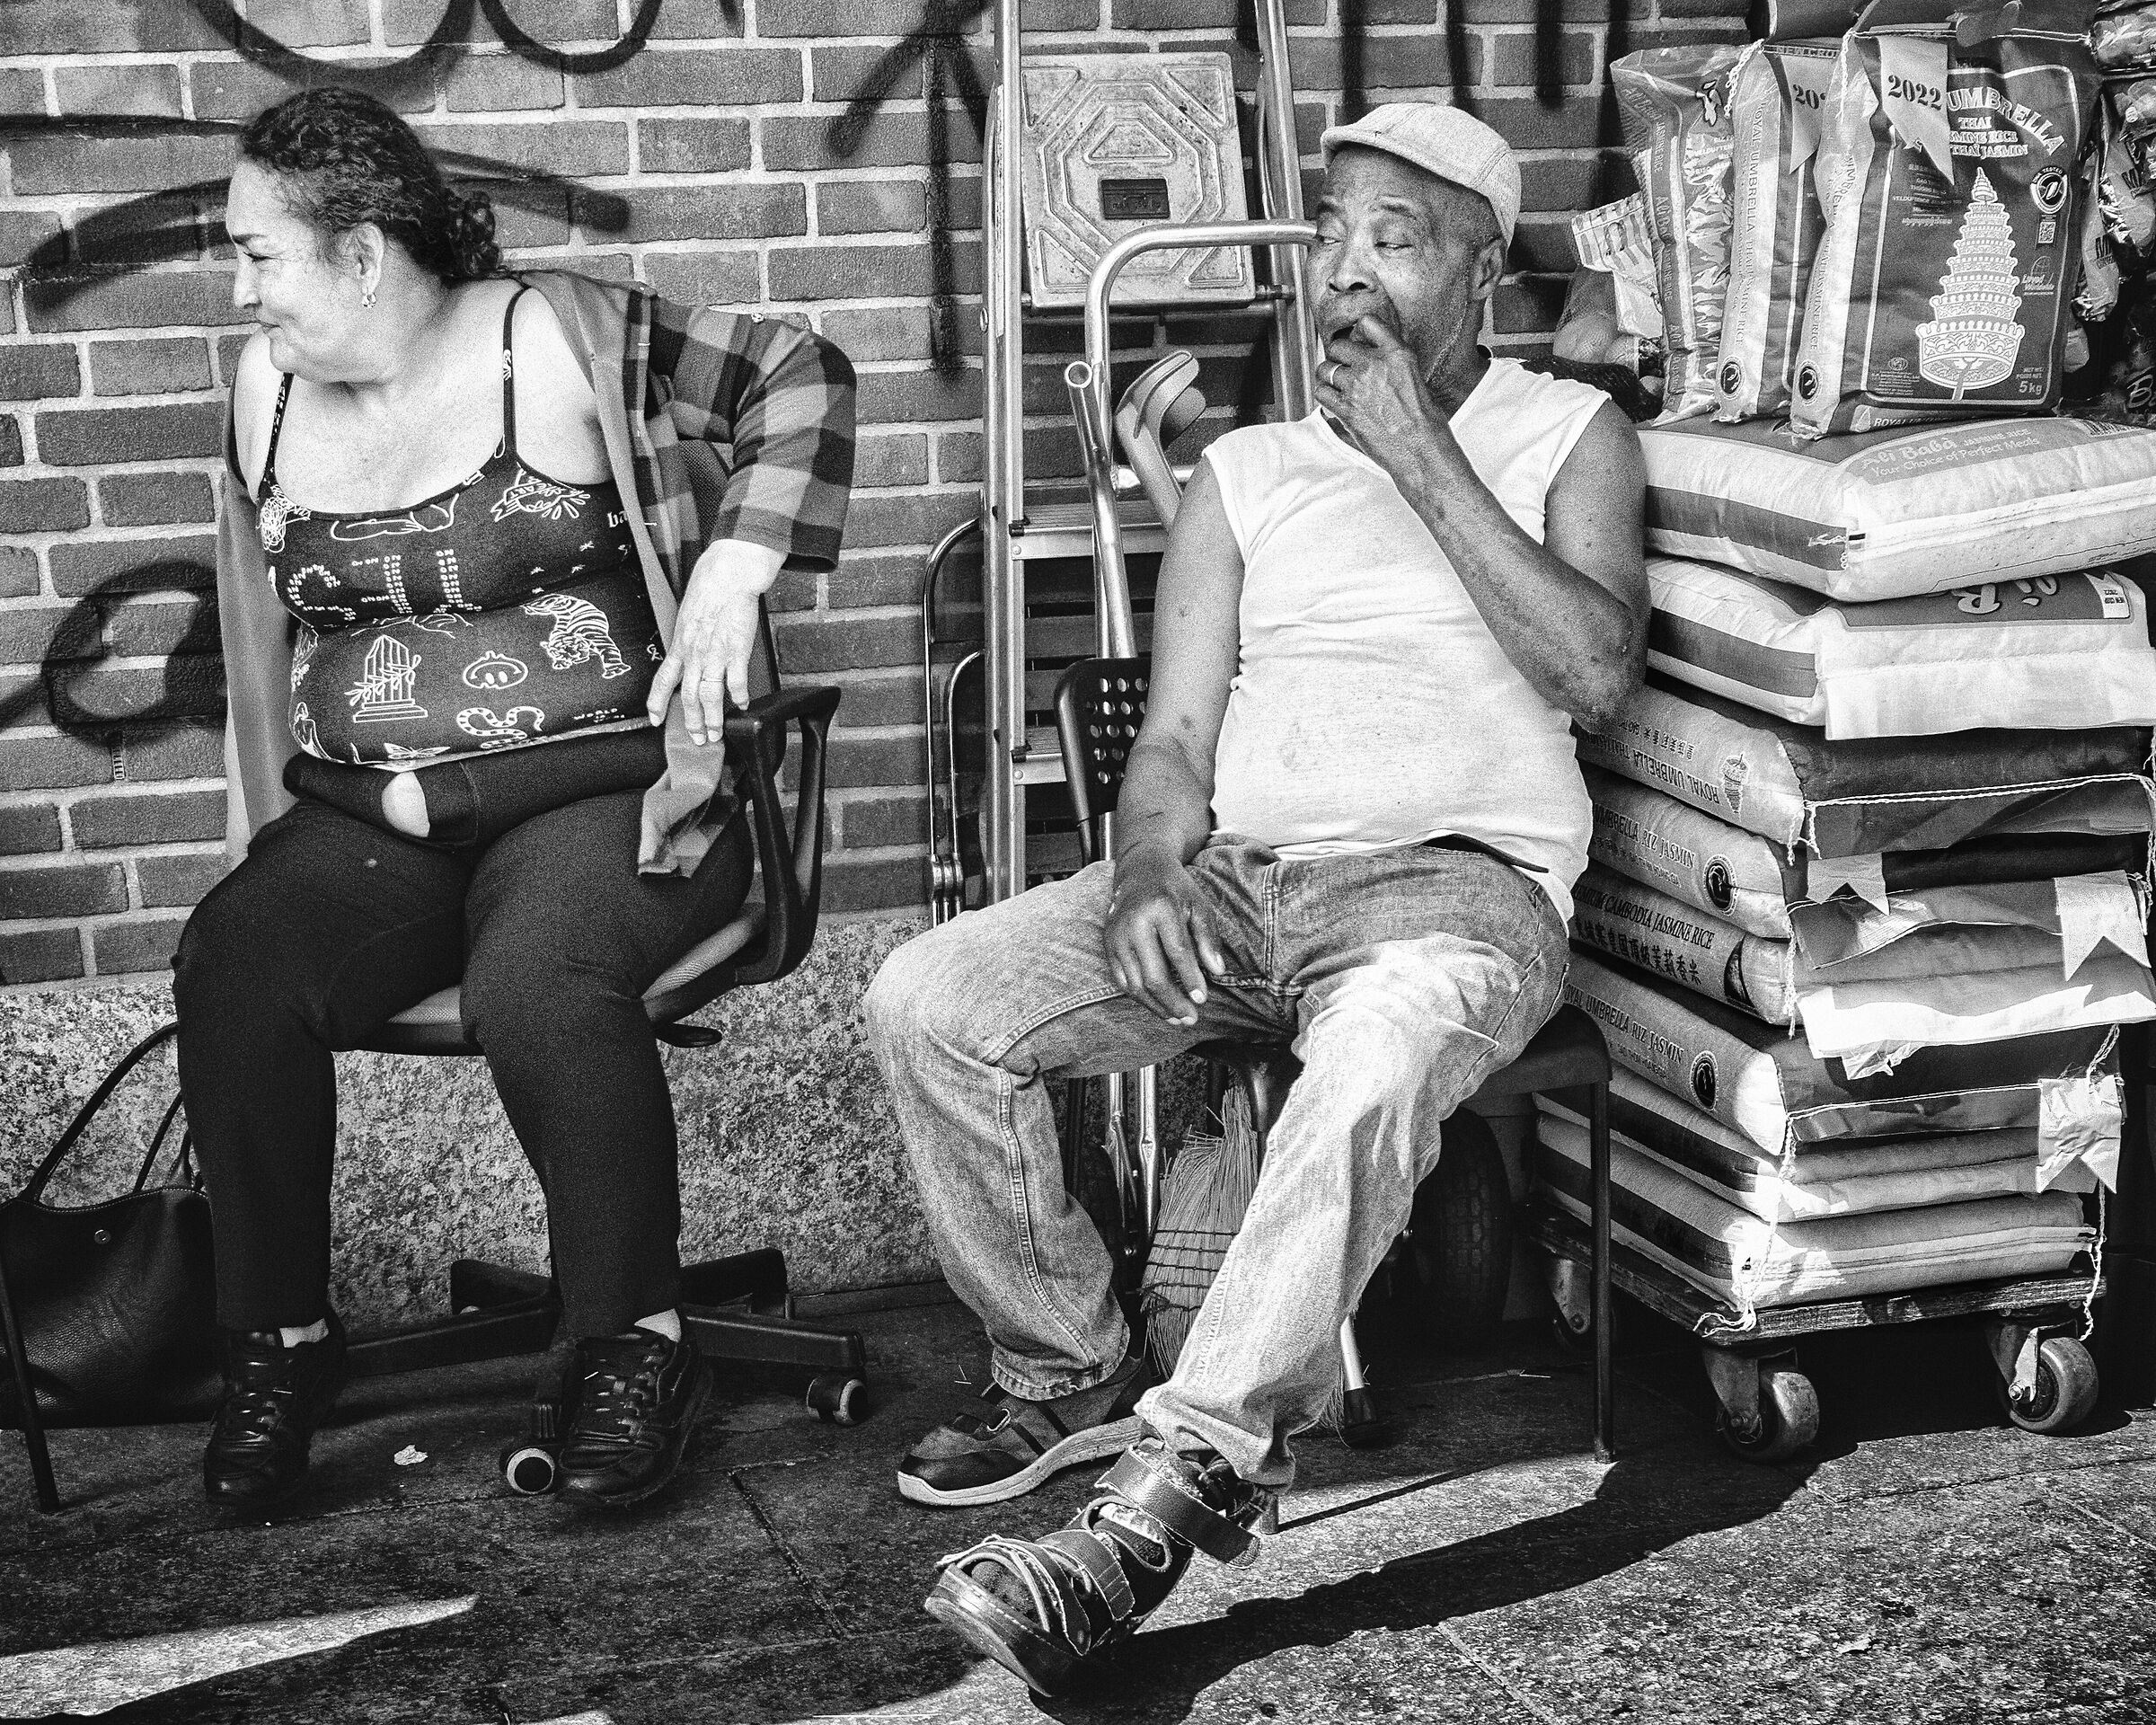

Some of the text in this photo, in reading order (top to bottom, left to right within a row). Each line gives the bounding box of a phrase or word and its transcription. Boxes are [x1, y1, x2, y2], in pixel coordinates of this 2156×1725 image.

[1792, 84, 1826, 110] 20
[1887, 74, 1942, 111] 2022
[1947, 86, 2065, 157] UMBRELLA
[1949, 130, 2019, 144] SMINE RICE
[1957, 117, 1992, 129] THAI
[1654, 121, 1666, 173] JASMINE RICE
[1980, 144, 2028, 160] JASMIN
[2042, 166, 2063, 175] TESTED
[1657, 195, 1672, 215] Ali
[1745, 150, 1763, 234] UMBRELLA
[1827, 154, 1857, 231] UMBRELLA
[1813, 267, 1828, 322] JASMINE
[1734, 318, 1745, 347] RICE
[1809, 322, 1821, 350] RICE
[1871, 437, 2040, 477] Your Choice of Perfect Meals
[1964, 432, 2006, 447] JASMINE
[1633, 748, 1686, 791] UMBRELLA
[1687, 775, 1720, 804] ROYAL
[1641, 829, 1659, 852] RIZ
[1659, 837, 1695, 868] JASMIN
[1604, 898, 1652, 929] CAMBODIA
[1651, 912, 1692, 943] JASMINE
[1690, 926, 1715, 950] RICE
[1564, 984, 1584, 1006] OYAL
[1586, 993, 1630, 1033] UMBRELLA
[1631, 1021, 1648, 1043] RIZ
[1648, 1030, 1685, 1065] JASMIN
